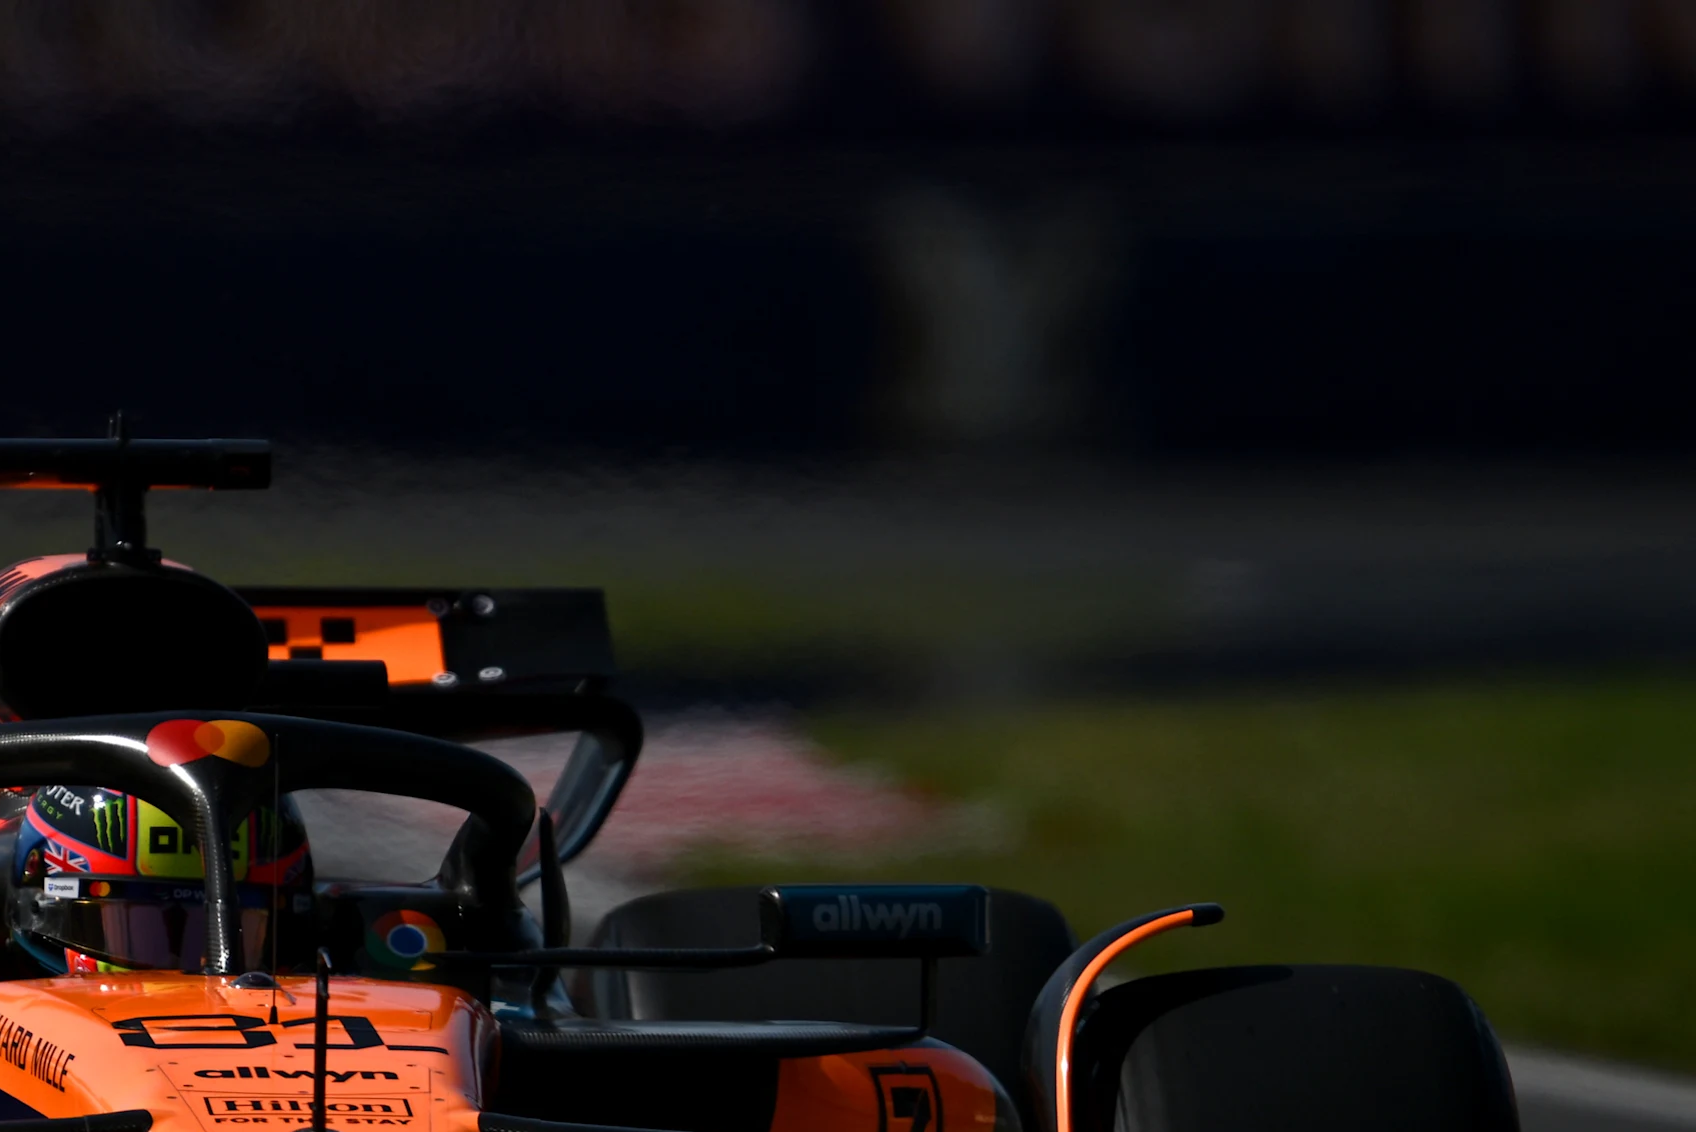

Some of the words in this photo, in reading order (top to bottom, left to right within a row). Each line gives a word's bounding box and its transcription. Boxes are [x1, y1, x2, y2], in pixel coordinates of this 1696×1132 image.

[812, 894, 943, 940] allwyn
[31, 1038, 75, 1092] MILLE
[194, 1066, 399, 1082] allwyn
[214, 1117, 267, 1125] FOR
[345, 1118, 412, 1127] STAY
